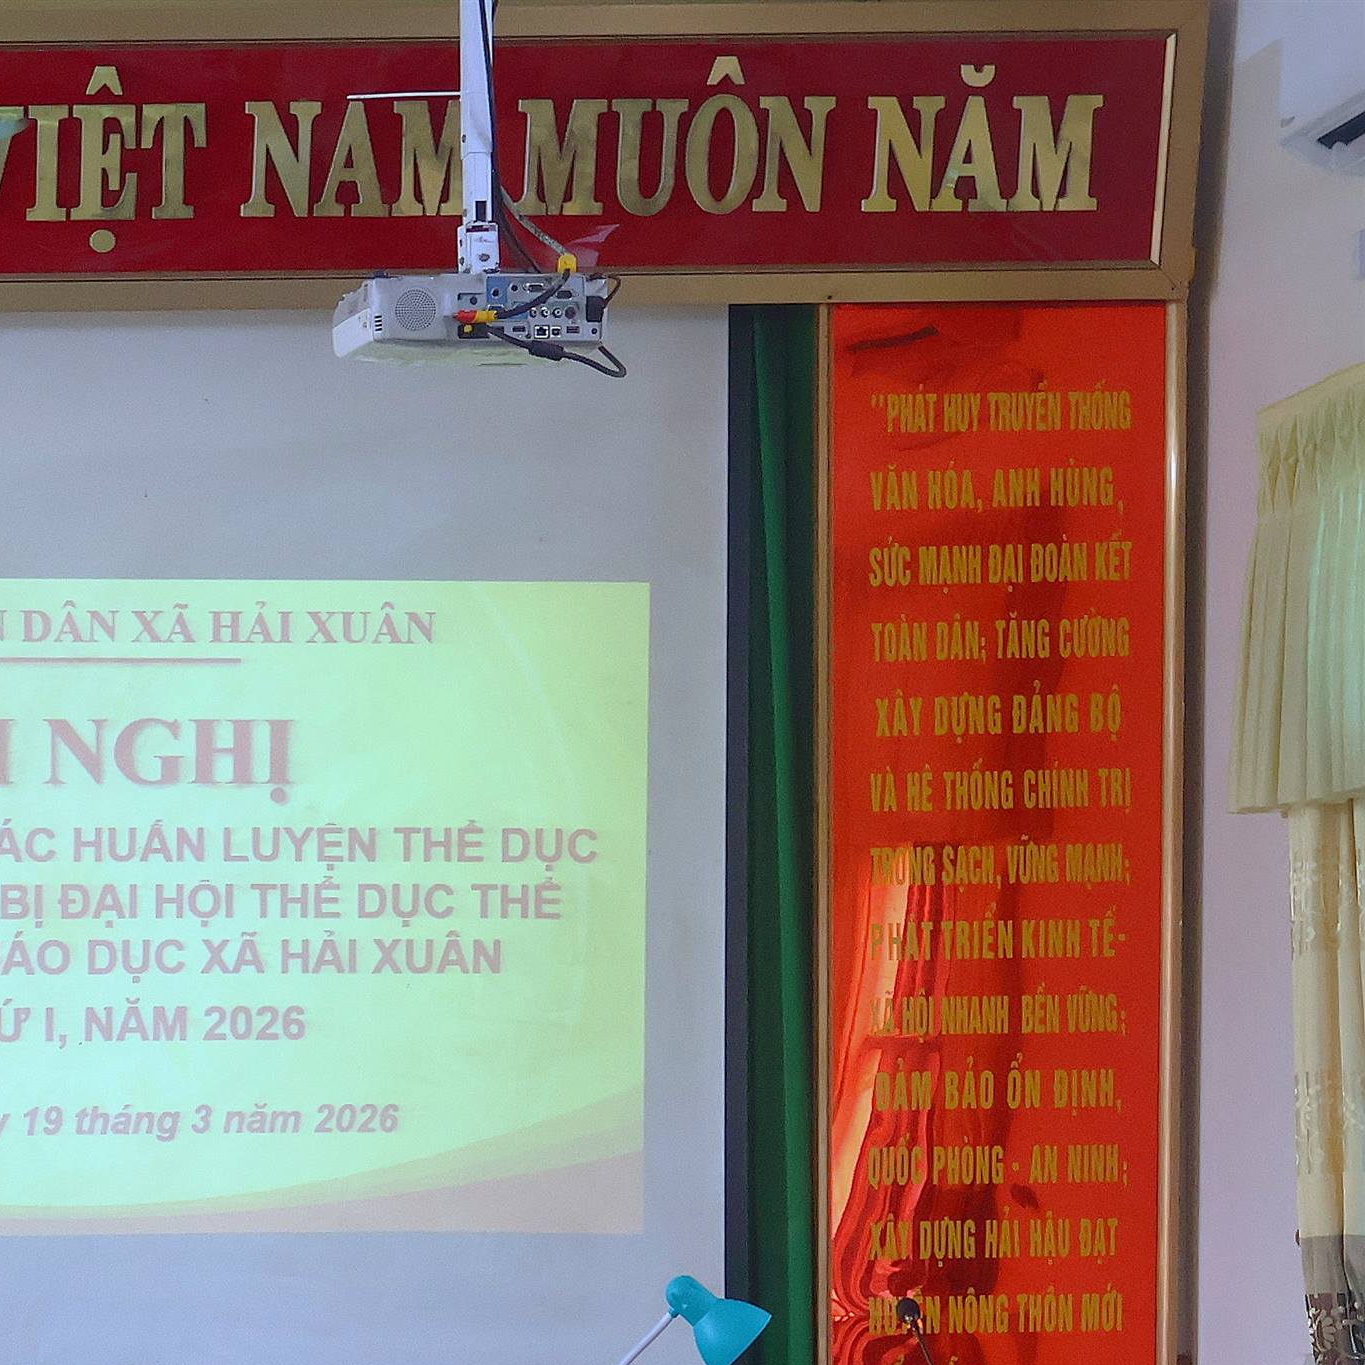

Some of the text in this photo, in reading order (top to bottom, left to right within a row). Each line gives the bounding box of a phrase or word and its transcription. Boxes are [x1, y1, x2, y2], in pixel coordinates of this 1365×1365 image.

[240, 97, 464, 218] NAM
[517, 54, 838, 216] MUÔN
[861, 63, 1104, 214] NĂM
[943, 393, 982, 433] HUY
[870, 463, 918, 511] VĂN
[992, 469, 1041, 508] ANH
[919, 545, 982, 594] MẠNH
[22, 600, 119, 644] DÂN
[131, 602, 197, 644] XÃ
[209, 601, 294, 645] HẢI
[305, 601, 437, 645] XUÂN
[872, 613, 928, 663] TOÀN
[996, 610, 1051, 660] TĂNG
[1012, 680, 1079, 735] ĐẢNG
[45, 717, 297, 806] NGHỊ
[1023, 760, 1090, 809] CHÍNH
[72, 819, 206, 864] HUẤN
[222, 822, 378, 872] LUYỆN
[500, 827, 600, 872] DỤC
[0, 884, 46, 929] BỊ
[57, 883, 139, 929] ĐẠI
[154, 880, 236, 929] HỘI
[357, 883, 456, 929] DỤC
[86, 938, 186, 984] DỤC
[199, 931, 266, 975] XÃ
[280, 930, 359, 975] HẢI
[371, 930, 503, 976] XUÂN
[1021, 919, 1082, 959] KINH
[82, 996, 189, 1042] NĂM
[201, 1004, 307, 1042] 2026
[941, 994, 1010, 1036] NHANH
[23, 1105, 64, 1138] 19
[74, 1104, 182, 1143] tháng
[190, 1104, 212, 1136] 3
[222, 1102, 302, 1135] năm
[314, 1103, 400, 1135] 2026
[932, 1135, 1005, 1185] PHÒNG
[1029, 1147, 1059, 1184] AN
[918, 1216, 976, 1267] DỰNG
[948, 1283, 1125, 1335] NÔNG THÔN MỚI
